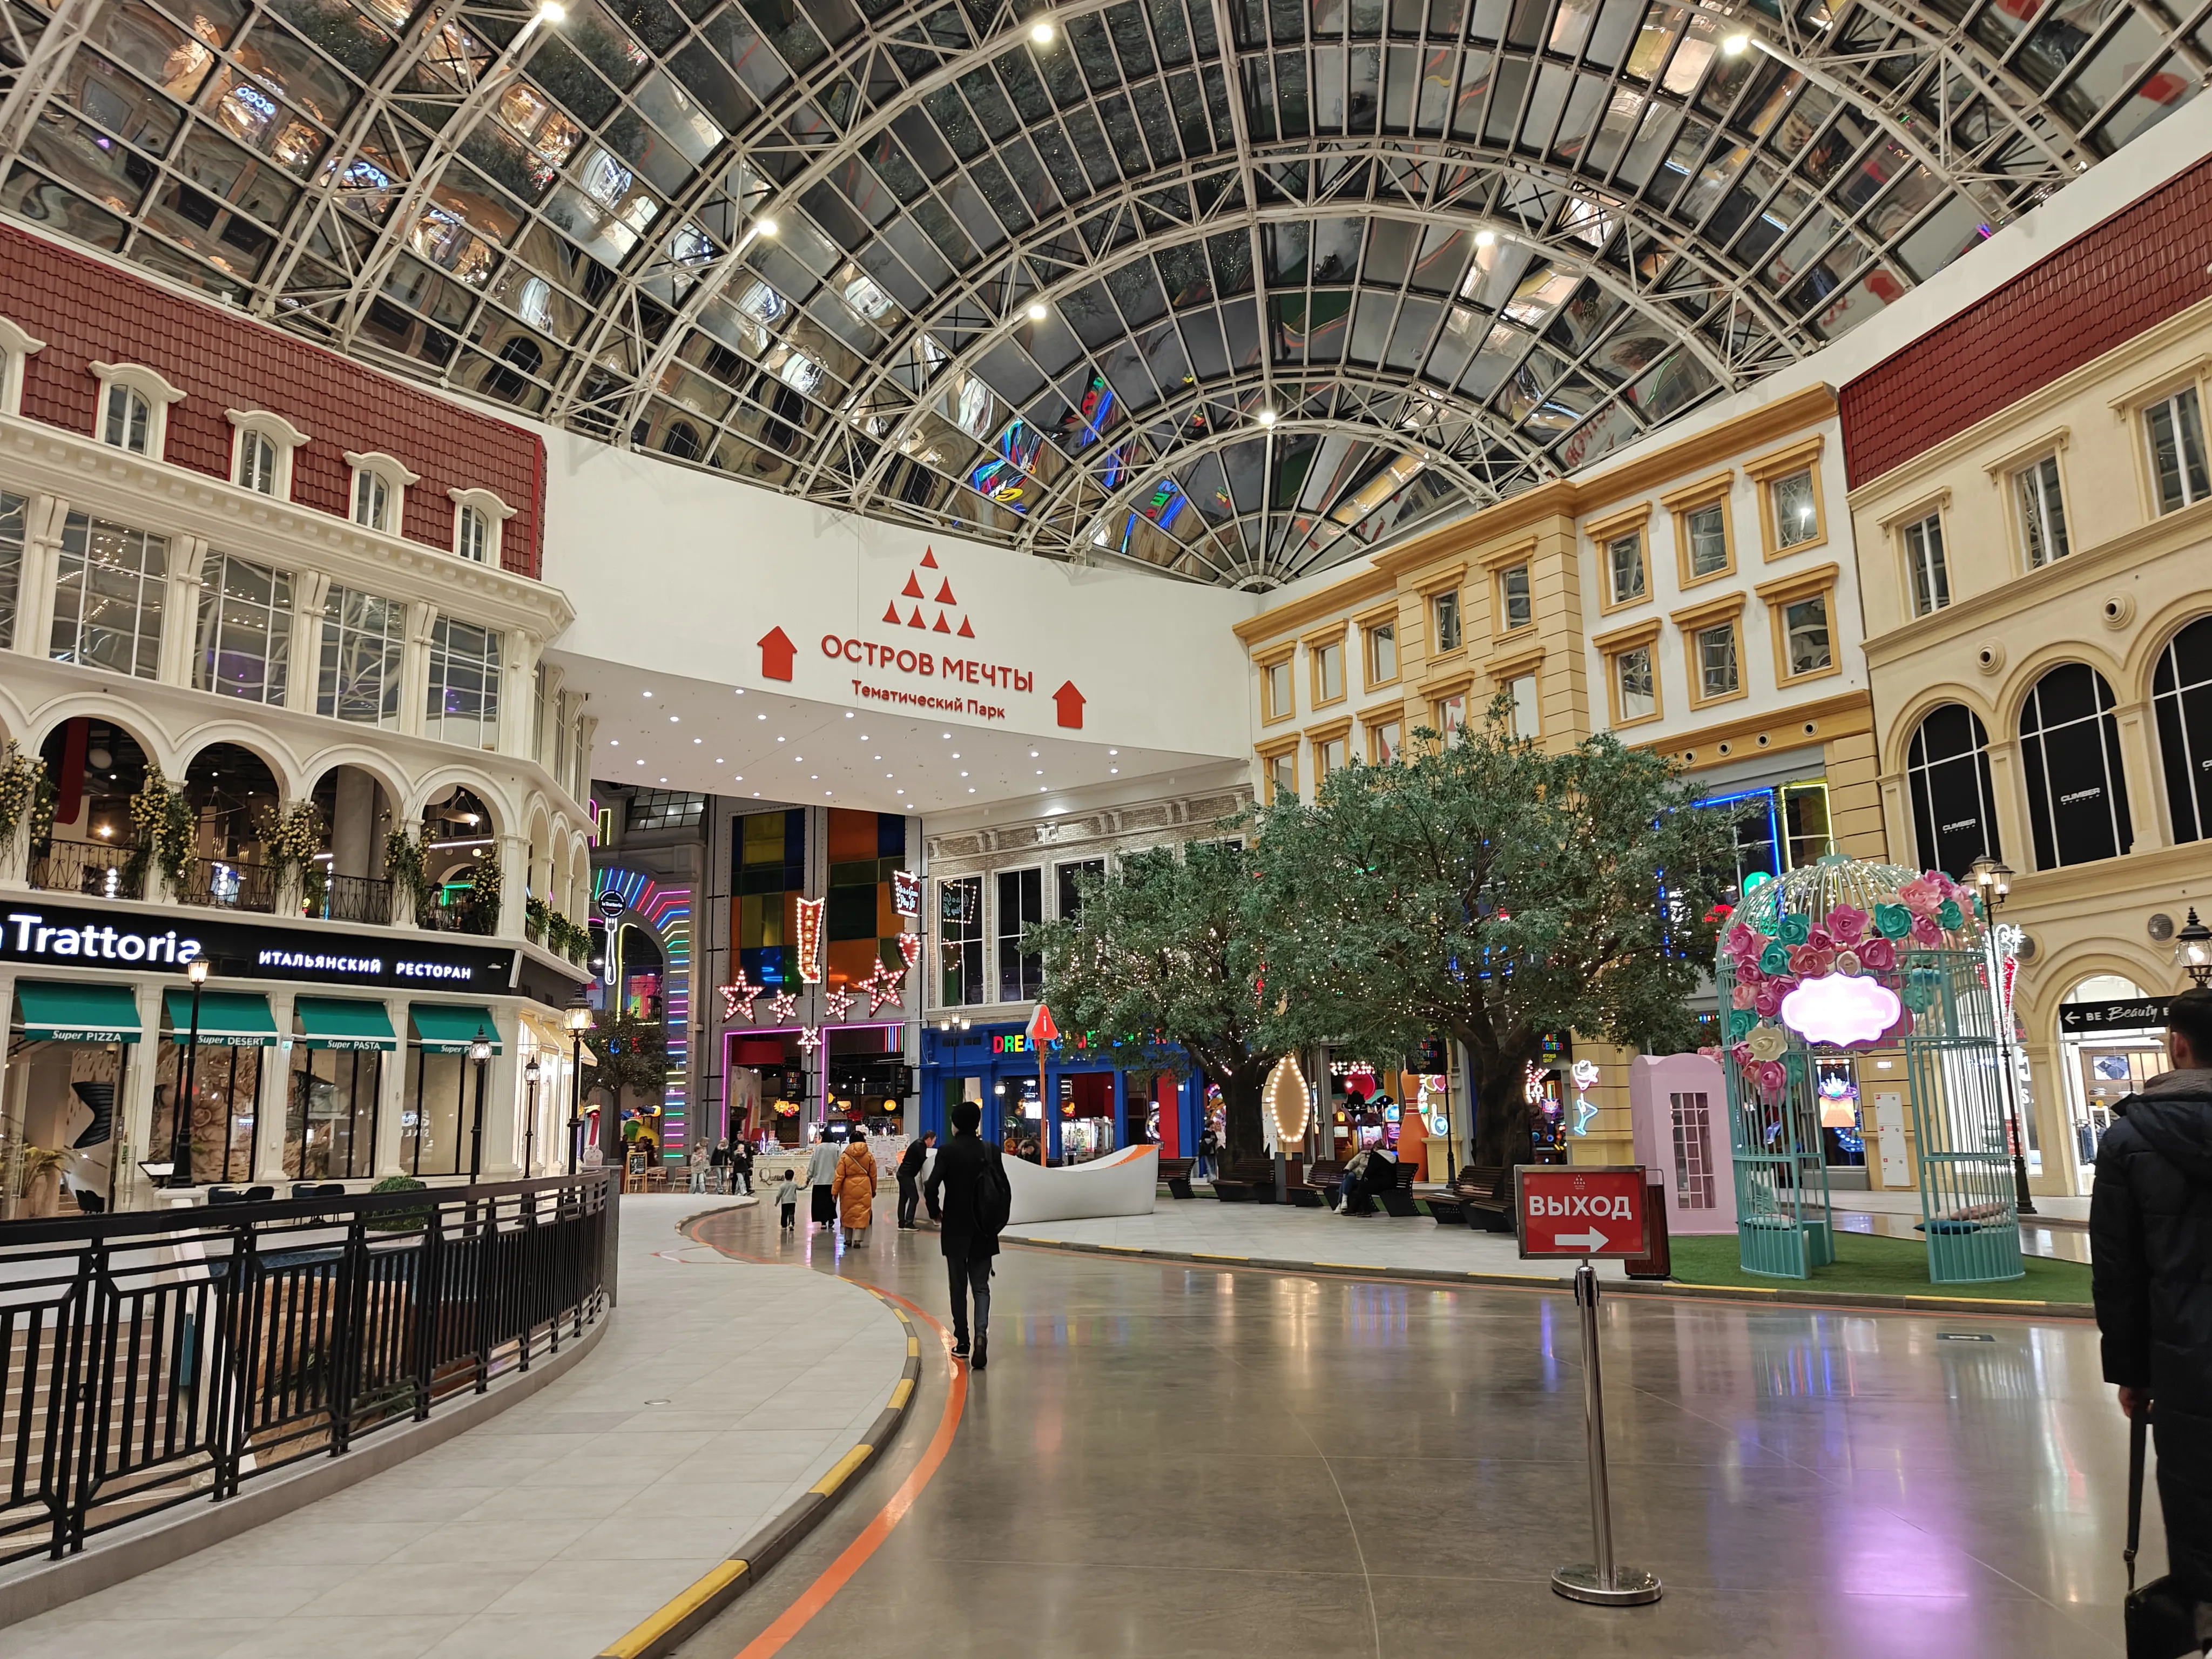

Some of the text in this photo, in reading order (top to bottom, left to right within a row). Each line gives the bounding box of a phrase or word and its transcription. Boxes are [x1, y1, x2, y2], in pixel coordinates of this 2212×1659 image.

[821, 634, 1034, 693] ОСТРОВ МЕЧТЫ
[851, 679, 1006, 720] Тематический Парк
[7, 913, 202, 964] Trattoria
[803, 907, 815, 974] ARCADE
[259, 950, 472, 980] ИТАЛЬЯНСКИЙ РЕСТОРАН
[2086, 1011, 2102, 1021] BE
[2106, 1004, 2158, 1023] Beauty
[52, 1029, 122, 1042] Super PIZZA
[197, 1034, 265, 1046] Super DESERT
[327, 1040, 381, 1050] Super PASTA
[1542, 1042, 1564, 1050] CENTER
[440, 1044, 462, 1054] Super
[1529, 1195, 1633, 1220] ВЫХОД
